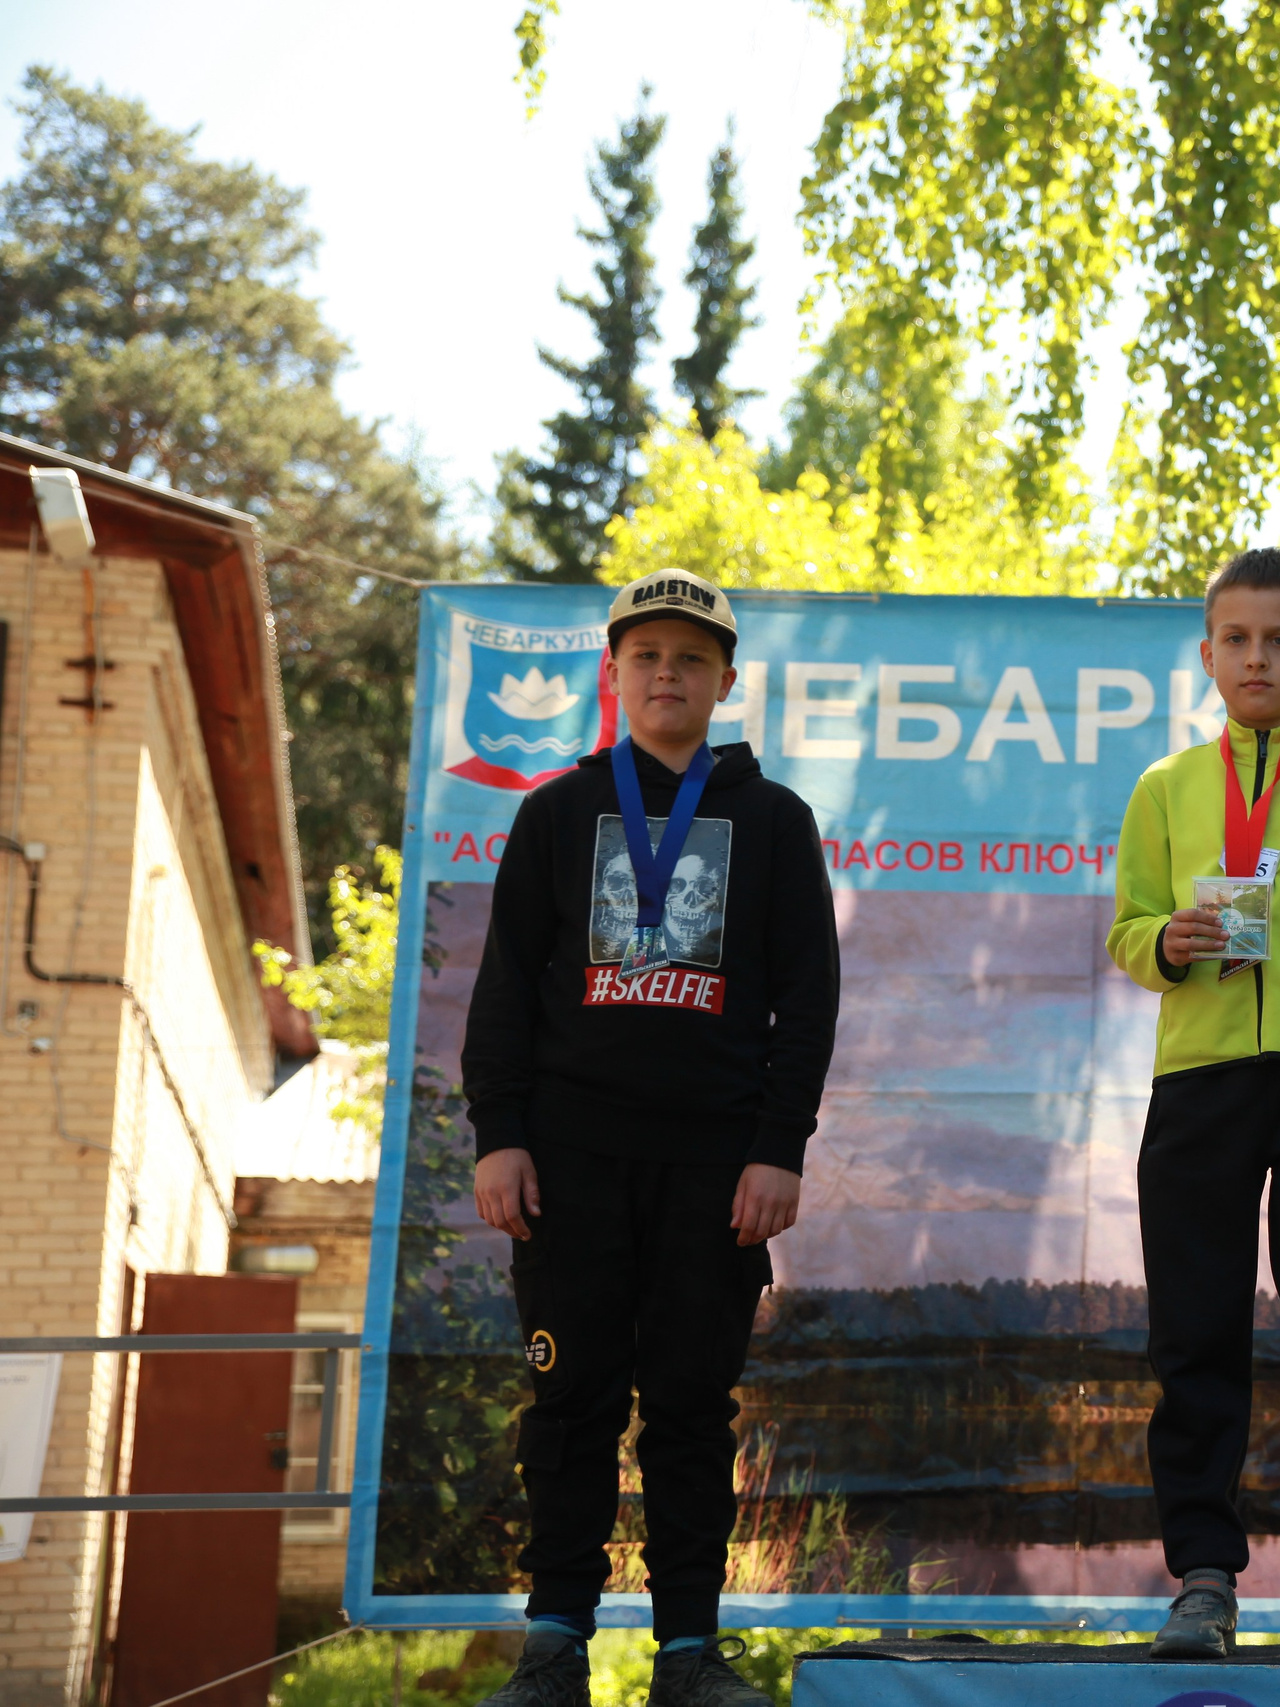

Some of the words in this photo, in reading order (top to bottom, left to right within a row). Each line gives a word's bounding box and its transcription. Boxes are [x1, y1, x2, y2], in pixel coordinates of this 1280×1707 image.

[632, 579, 716, 610] BARSTOW
[464, 620, 608, 650] ЧЕБАРКУЛЬ
[820, 839, 965, 872] ПАСОВ
[1255, 862, 1269, 878] 5
[591, 969, 721, 1009] #SKELFIE
